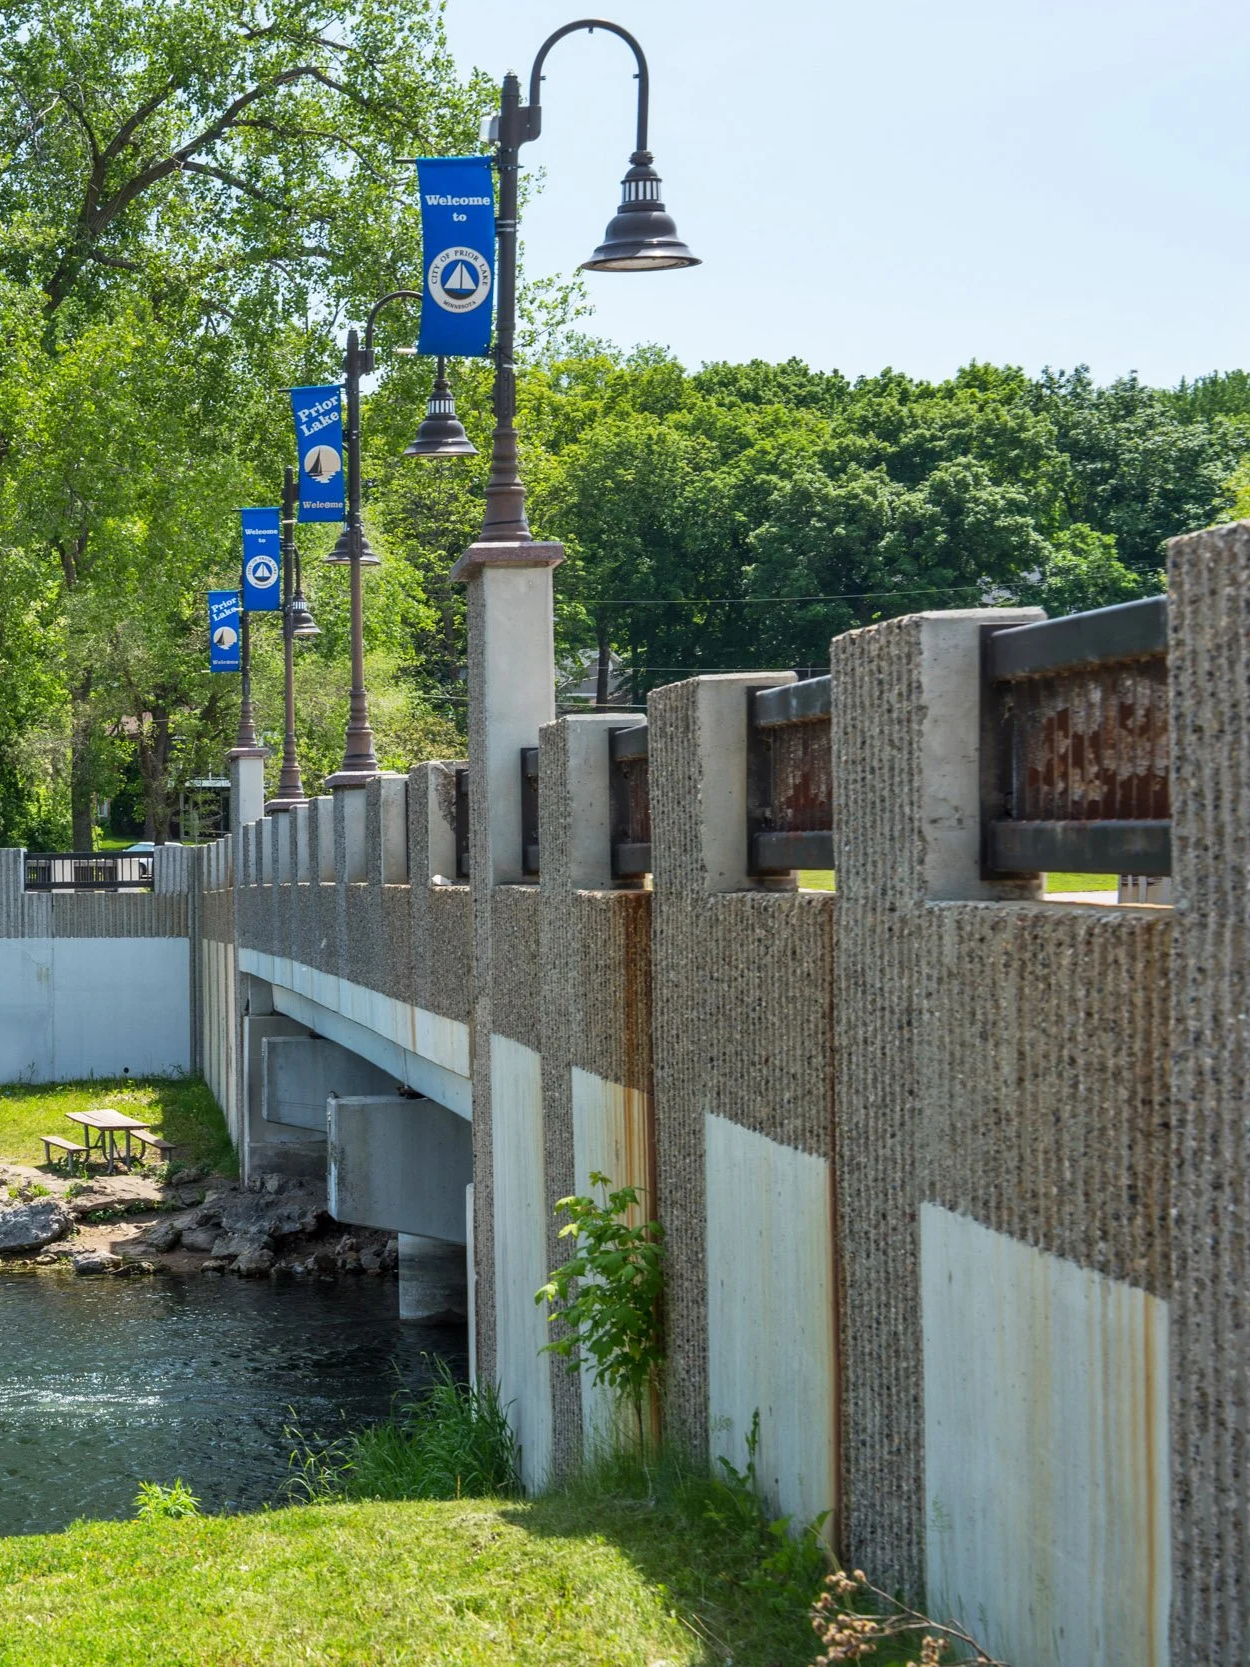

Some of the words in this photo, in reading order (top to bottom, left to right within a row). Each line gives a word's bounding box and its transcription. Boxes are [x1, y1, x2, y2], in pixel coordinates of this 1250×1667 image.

[425, 195, 491, 206] Welcome
[452, 212, 467, 222] to
[431, 264, 440, 285] CITY
[440, 252, 451, 263] OF
[454, 249, 479, 262] PRIOR
[479, 263, 488, 286] LAKE
[443, 300, 477, 310] MINNESOTA
[297, 396, 339, 423] Prior
[300, 411, 340, 437] Lake
[302, 501, 344, 509] Welcome
[211, 597, 237, 613] Prior
[212, 607, 237, 622] Lake
